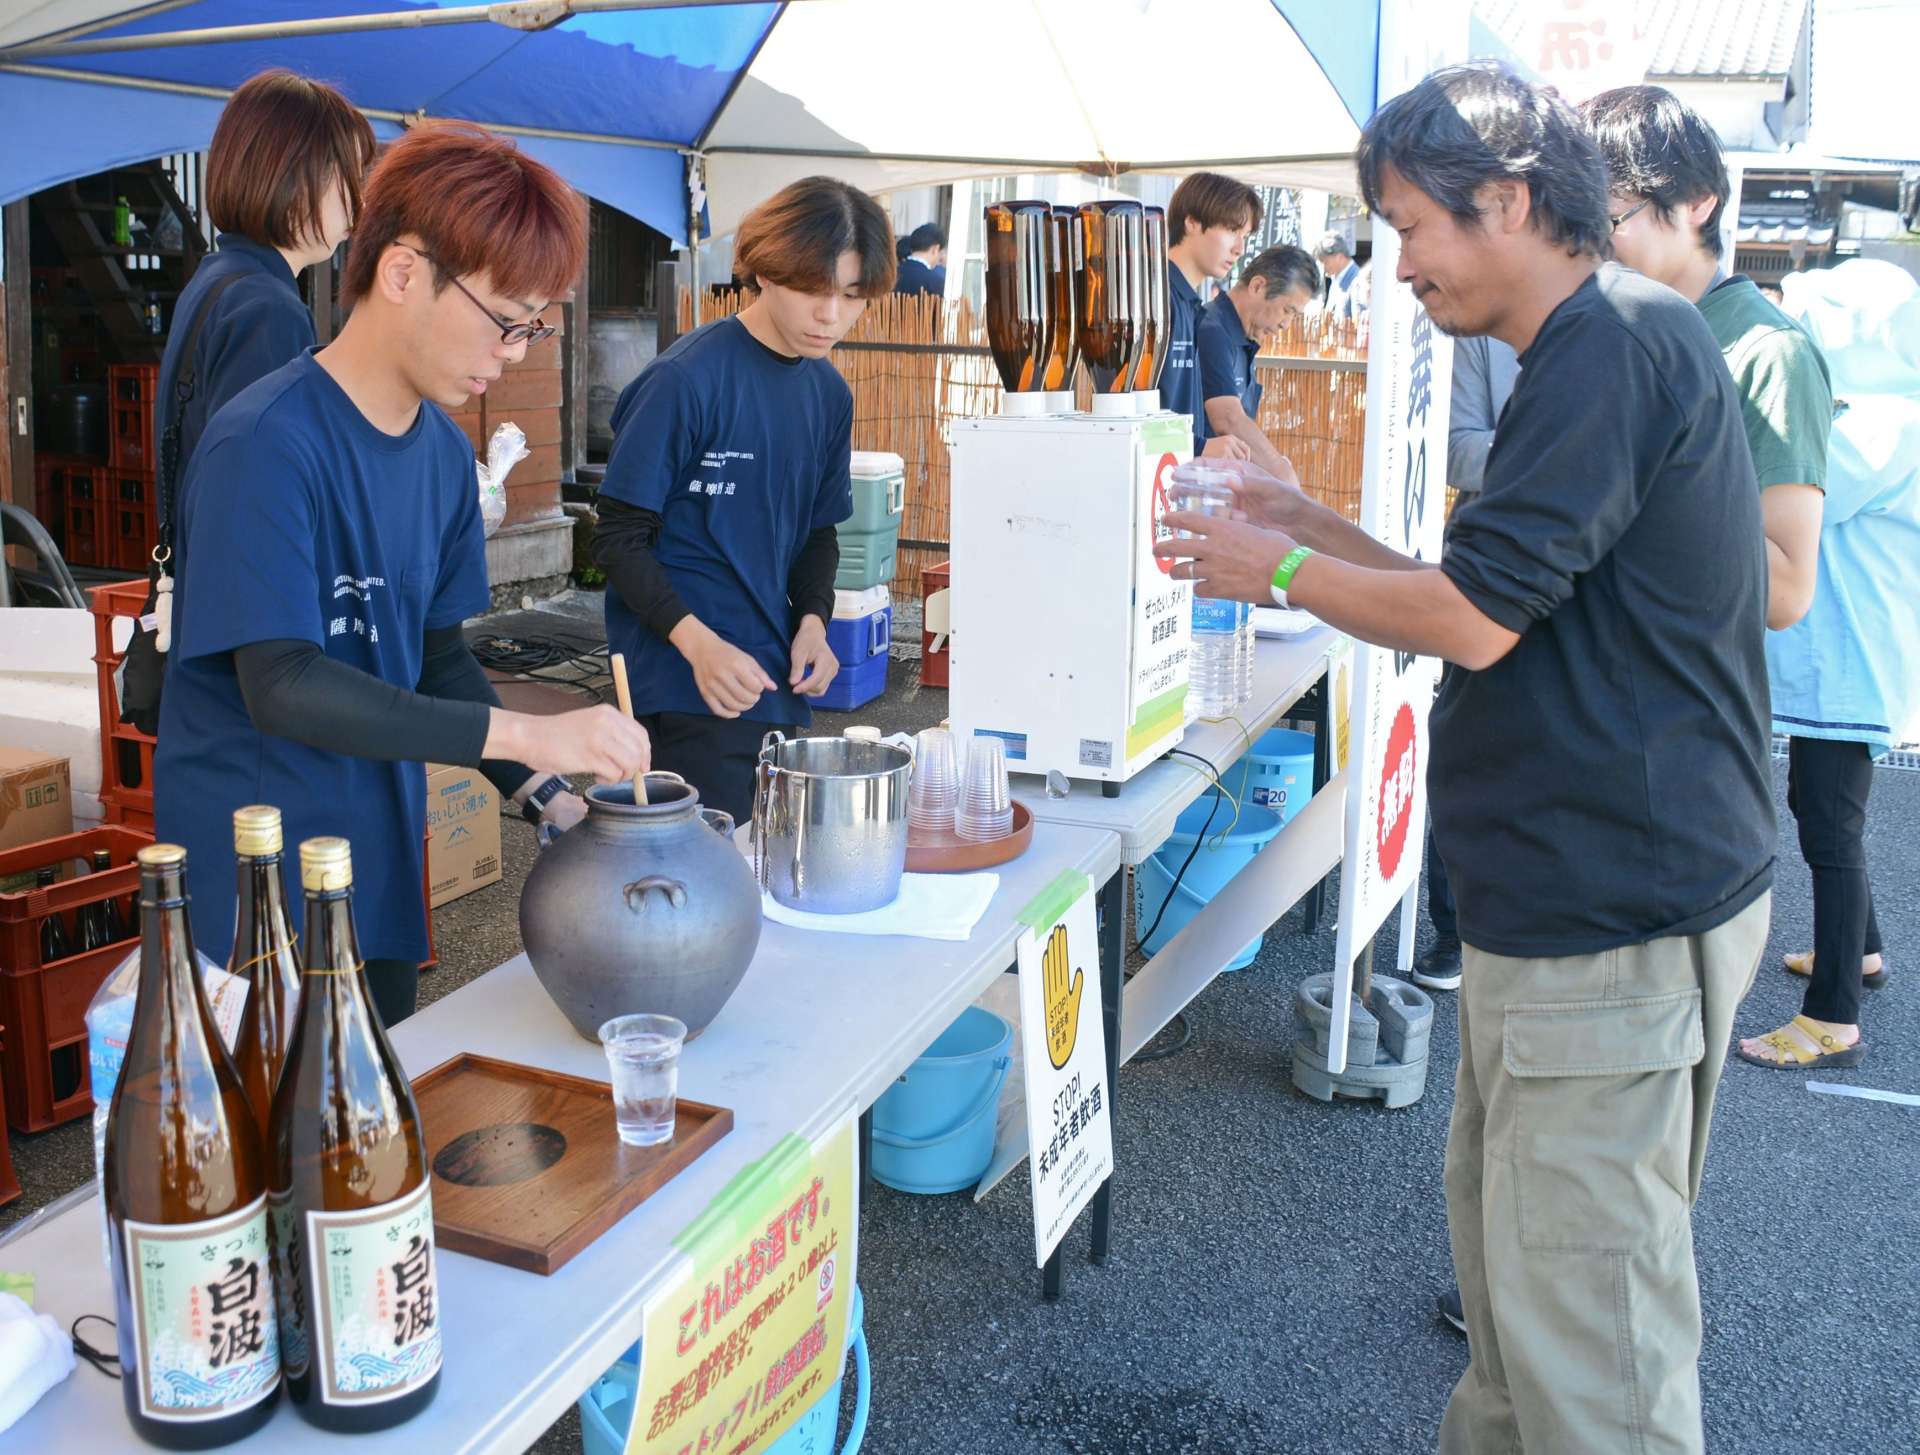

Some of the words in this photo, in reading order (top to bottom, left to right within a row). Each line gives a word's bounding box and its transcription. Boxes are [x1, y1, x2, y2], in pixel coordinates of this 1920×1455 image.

[1269, 790, 1287, 804] 20
[1039, 1082, 1103, 1184] 未成年者飲酒
[1053, 1071, 1082, 1126] STOP!
[206, 1257, 264, 1368] 白波
[392, 1234, 435, 1347] 白波
[676, 1176, 831, 1357] これはお酒です。
